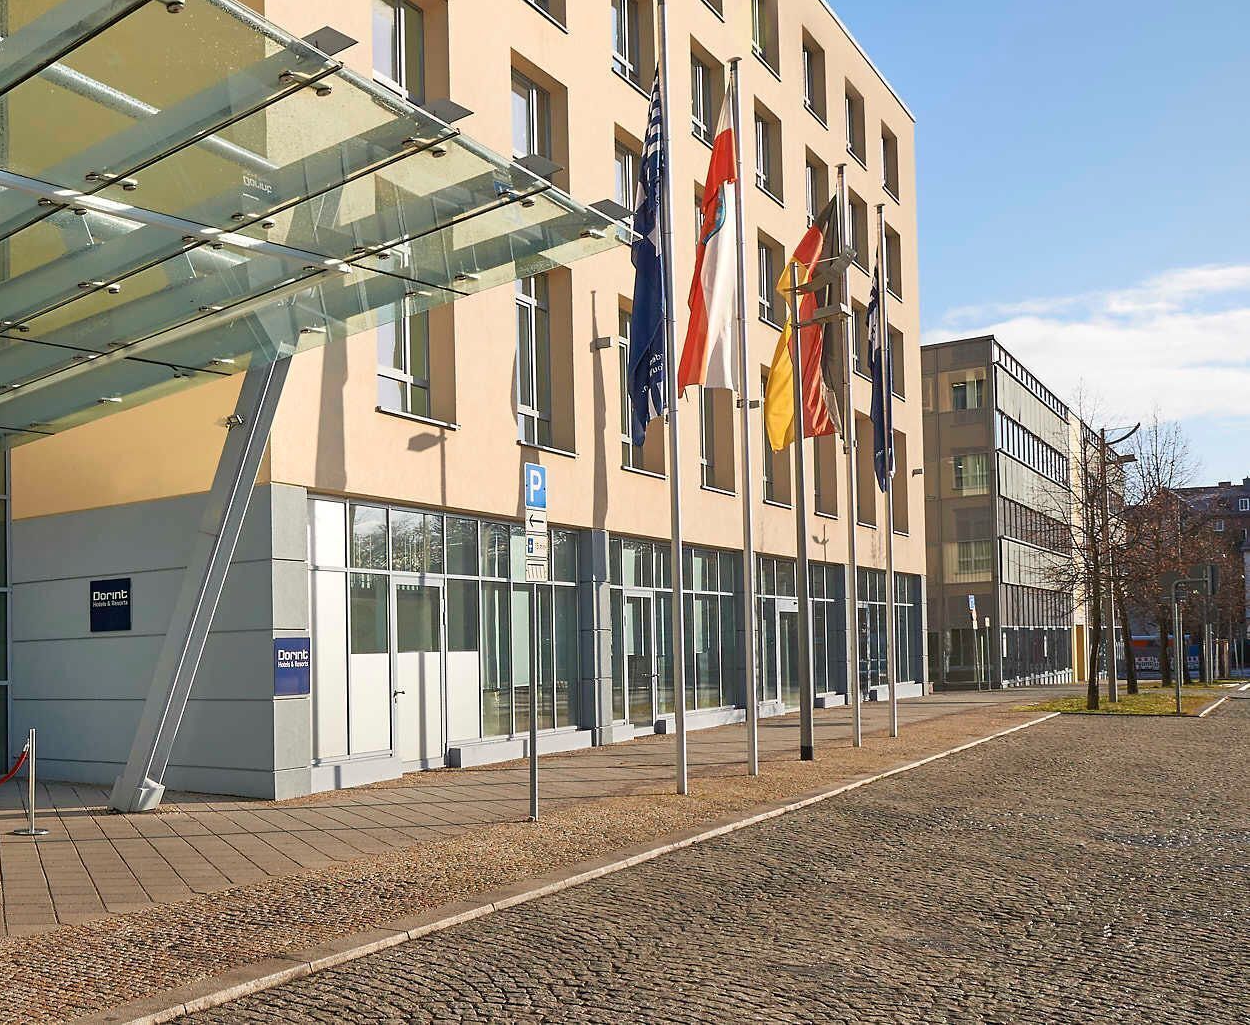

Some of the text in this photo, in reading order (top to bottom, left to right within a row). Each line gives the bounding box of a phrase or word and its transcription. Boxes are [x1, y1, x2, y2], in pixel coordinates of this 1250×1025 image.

[529, 469, 542, 503] P
[93, 590, 128, 601] Dorint
[278, 649, 309, 661] Dorint
